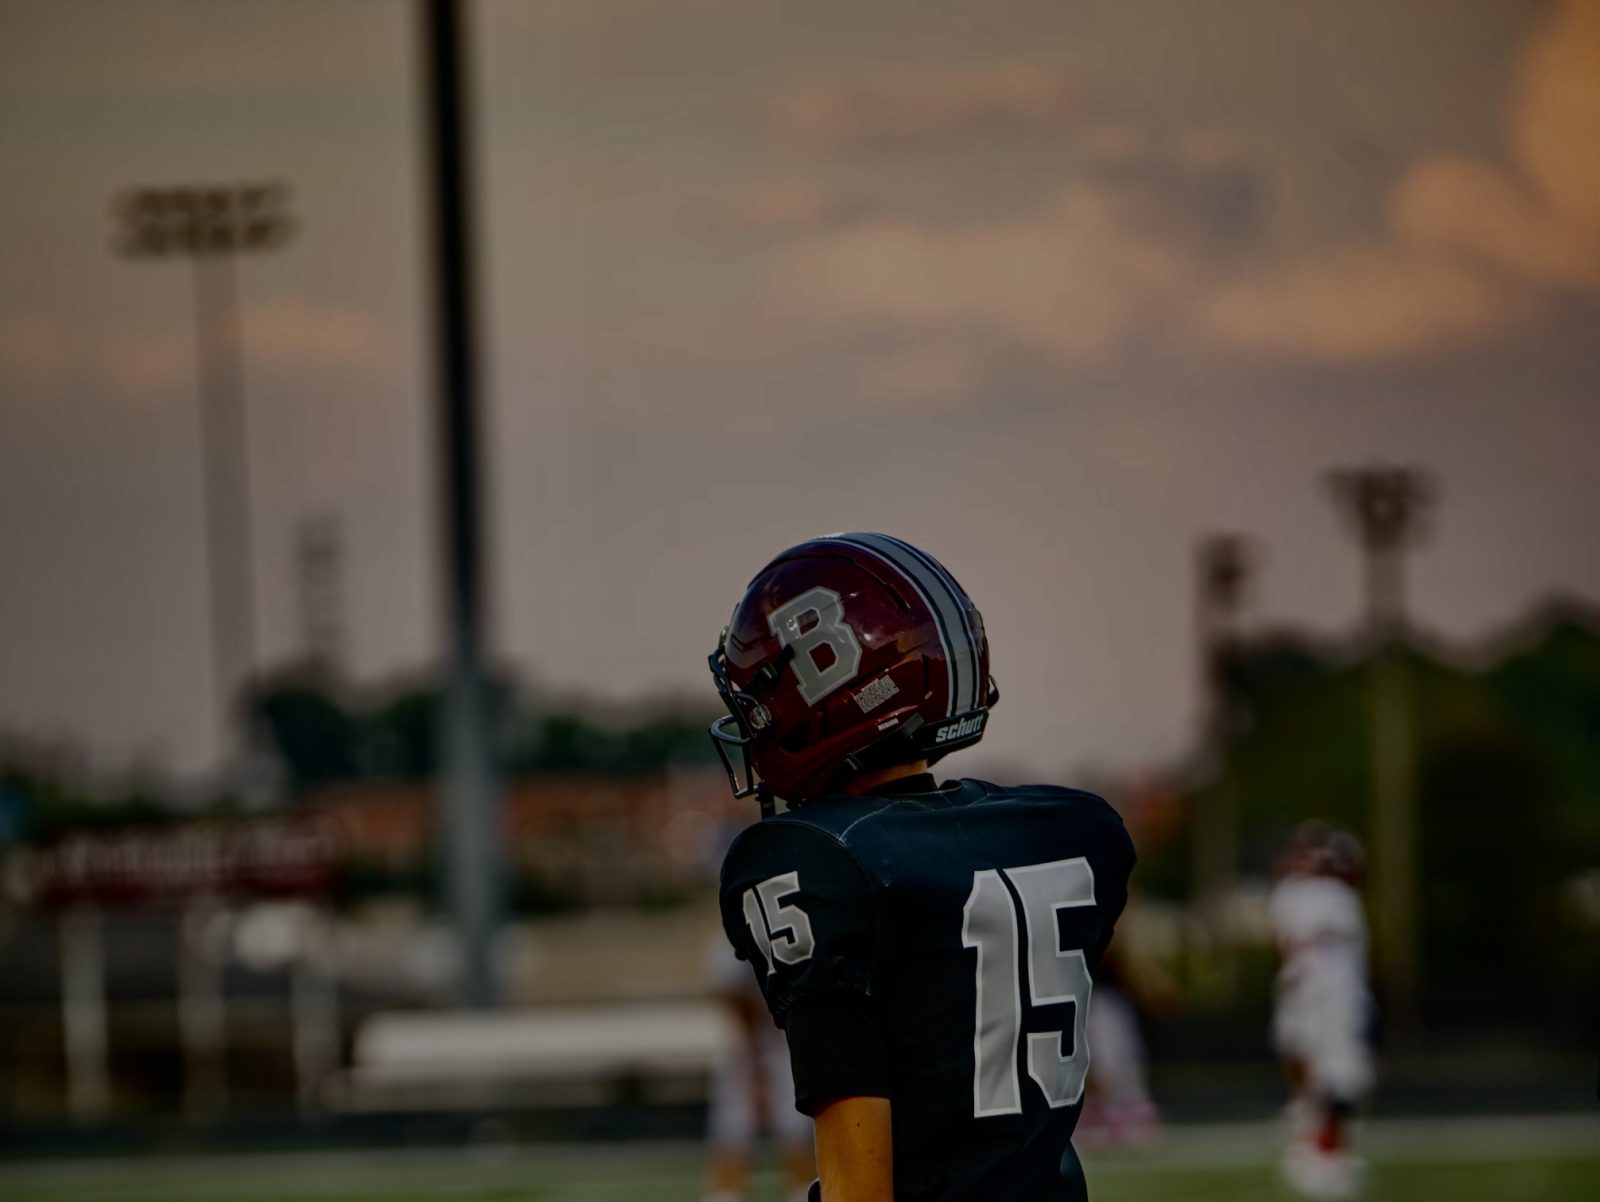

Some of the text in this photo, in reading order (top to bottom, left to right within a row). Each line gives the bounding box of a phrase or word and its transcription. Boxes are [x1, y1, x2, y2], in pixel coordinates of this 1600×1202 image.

[767, 585, 863, 708] B
[742, 870, 816, 976] 15
[963, 856, 1098, 1119] 15
